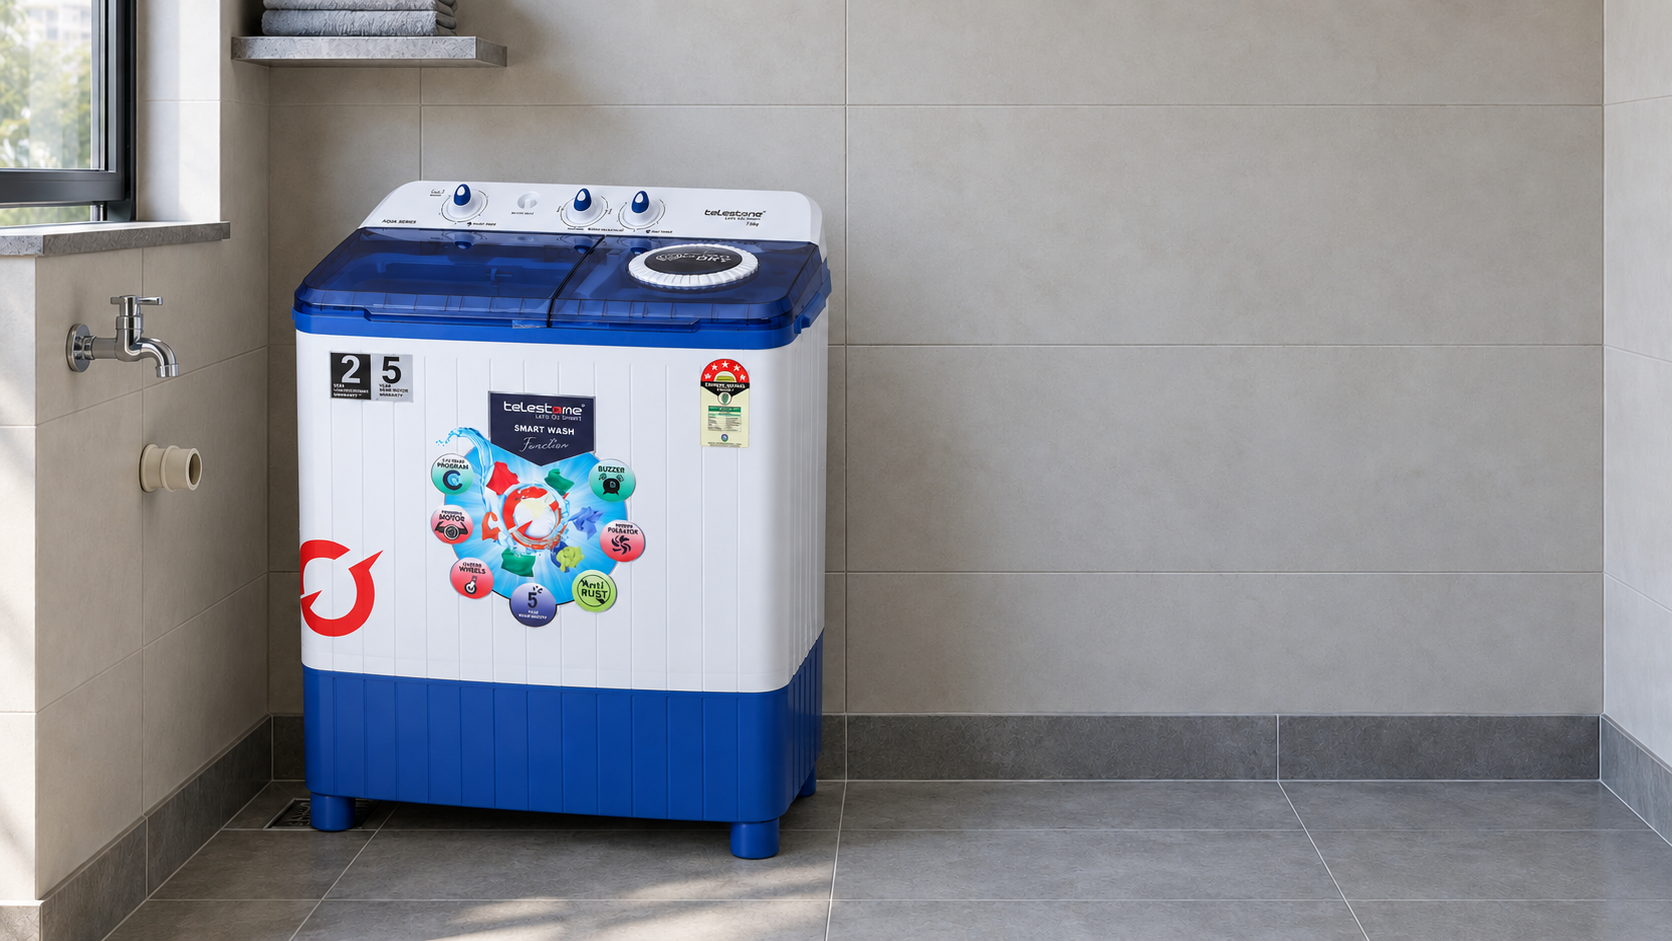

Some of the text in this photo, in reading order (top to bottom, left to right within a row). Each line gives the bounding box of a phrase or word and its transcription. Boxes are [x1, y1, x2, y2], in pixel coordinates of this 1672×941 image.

[341, 355, 361, 383] 2
[382, 356, 402, 384] 5
[514, 424, 575, 436] SMART WASH
[527, 591, 538, 609] 5
[581, 588, 608, 599] RUST
